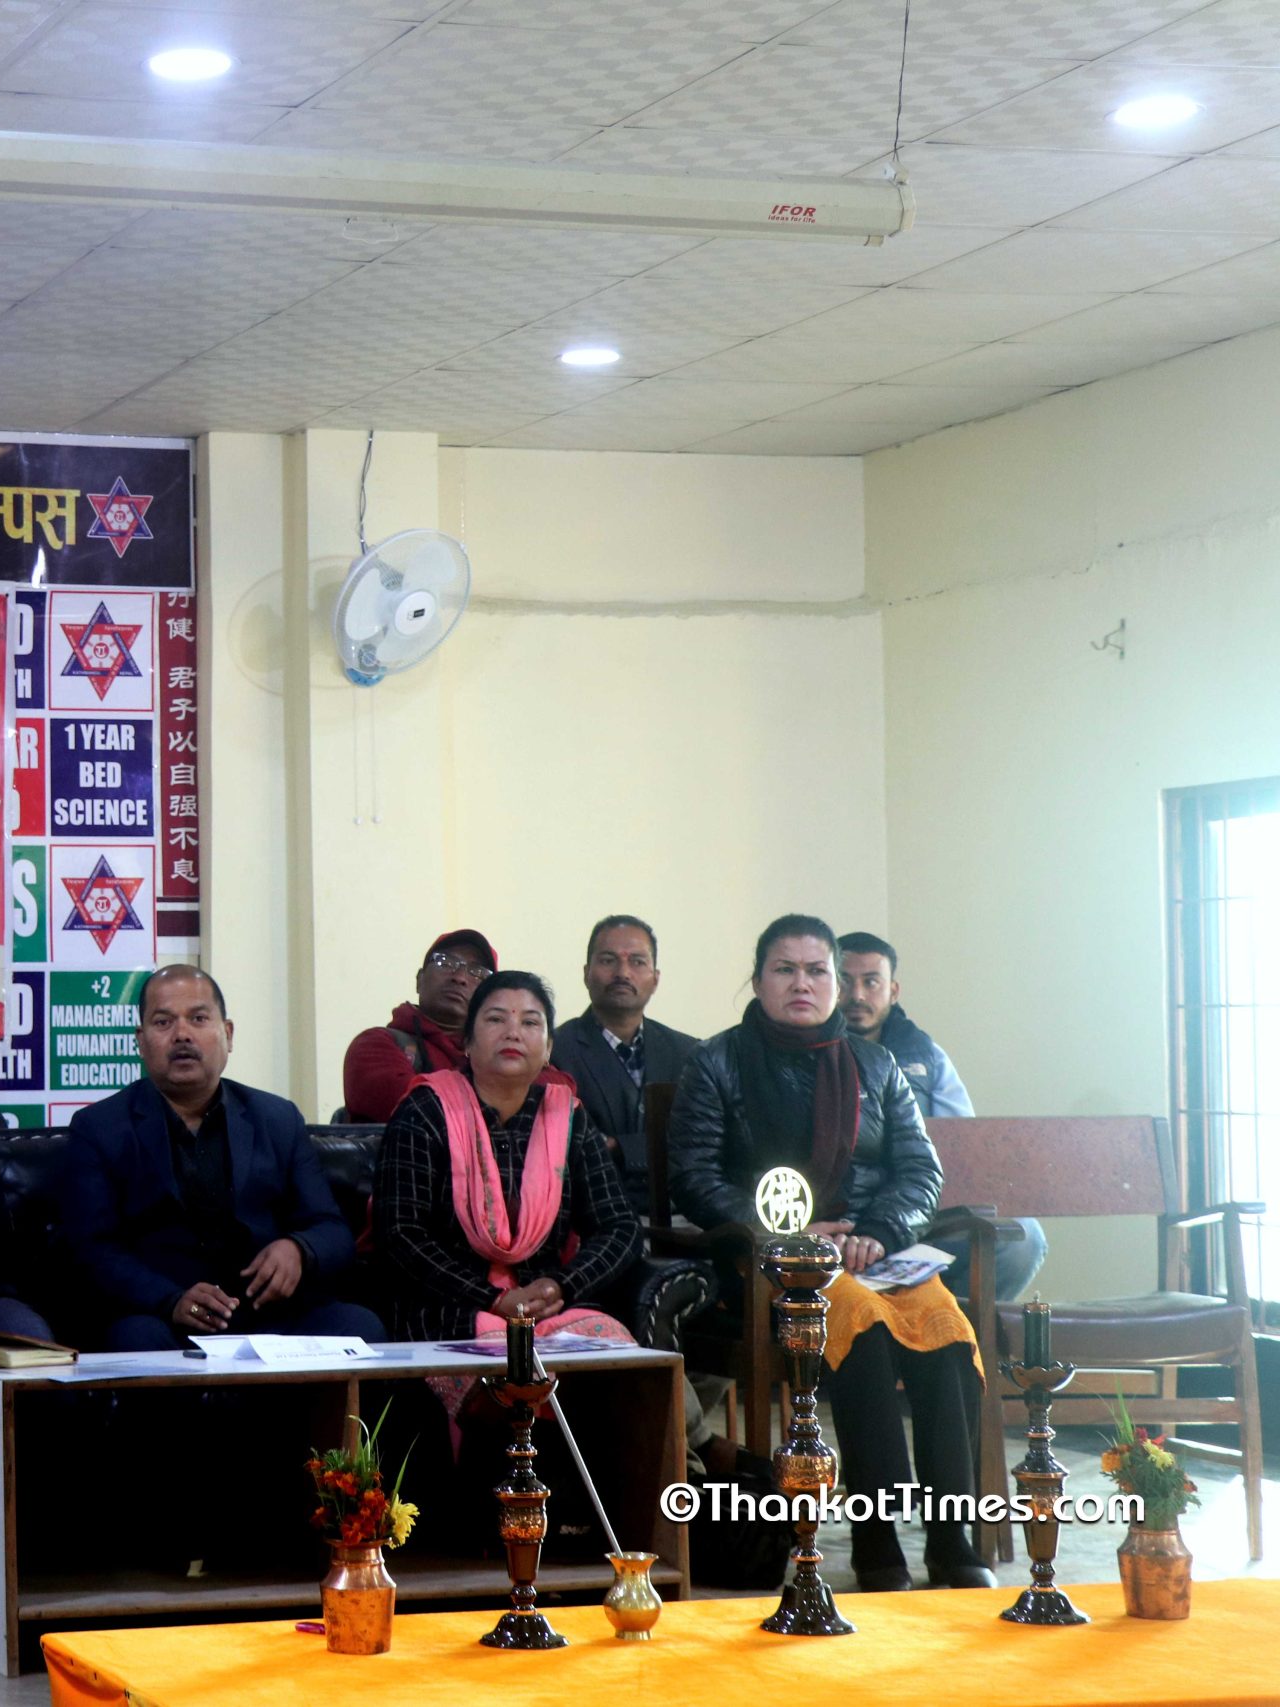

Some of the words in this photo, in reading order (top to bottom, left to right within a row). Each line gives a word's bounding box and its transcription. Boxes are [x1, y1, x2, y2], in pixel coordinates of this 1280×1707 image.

[771, 204, 816, 217] IFOR
[64, 723, 76, 750] 1
[80, 723, 135, 751] YEAR
[79, 761, 122, 788] BED
[54, 798, 148, 826] SCIENCE
[91, 975, 111, 998] +2
[61, 1063, 141, 1087] EDUCATION
